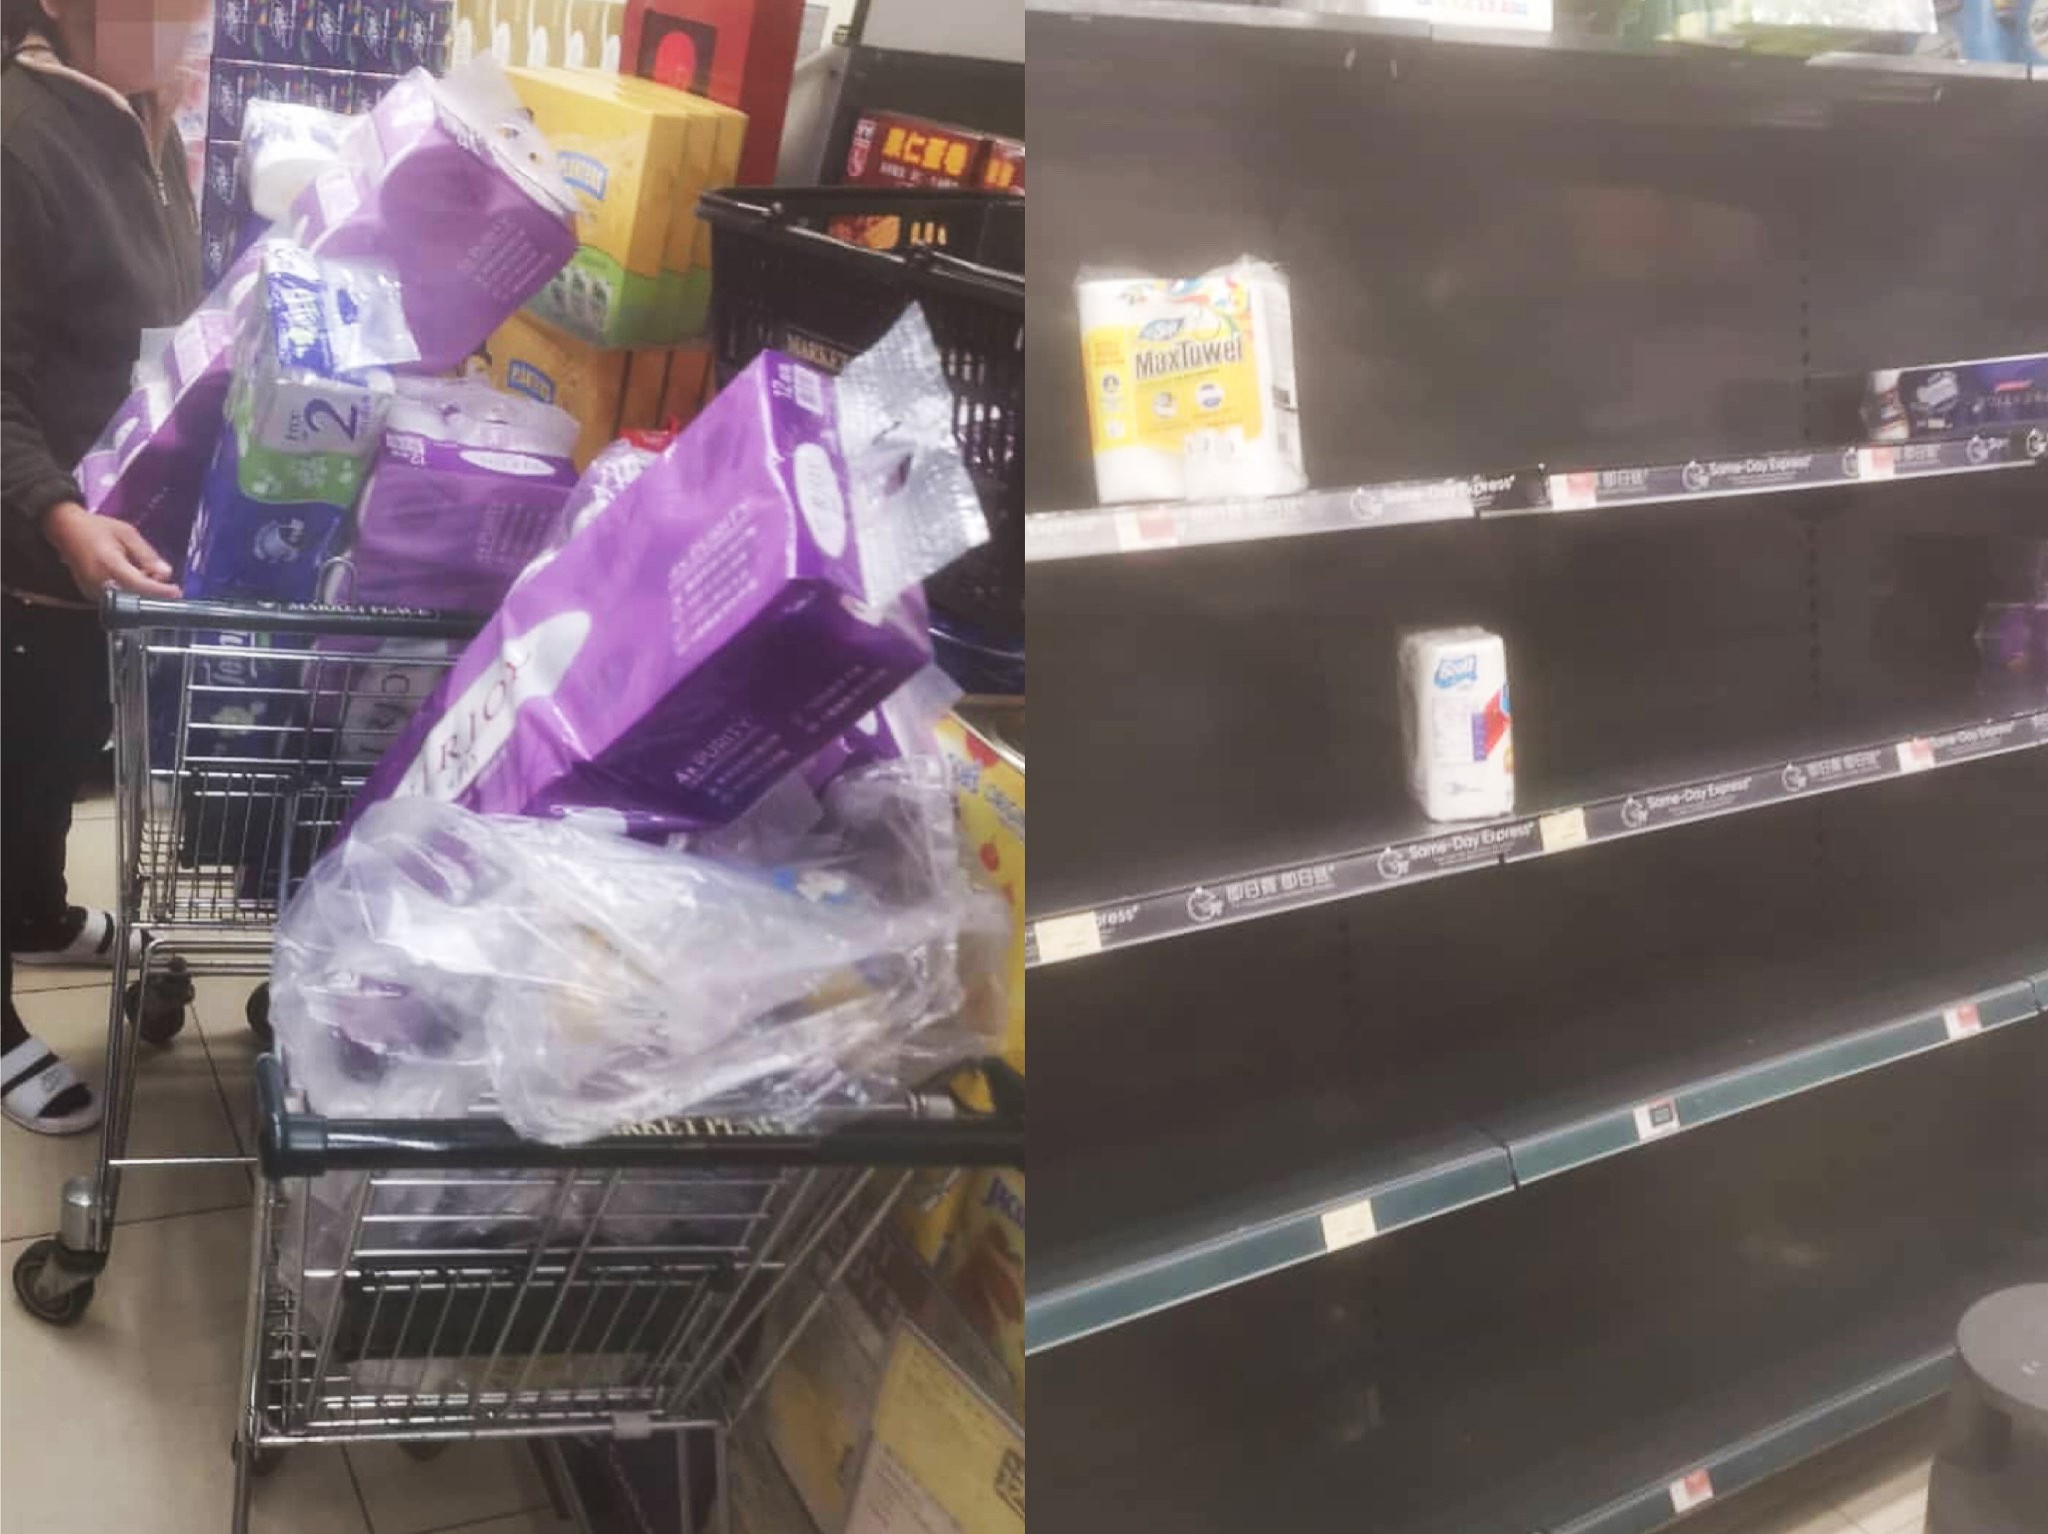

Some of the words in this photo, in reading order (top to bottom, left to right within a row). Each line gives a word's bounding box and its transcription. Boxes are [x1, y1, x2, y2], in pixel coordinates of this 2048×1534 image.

[303, 398, 358, 441] 2
[1408, 835, 1480, 860] Same-Day
[1481, 821, 1535, 844] Express
